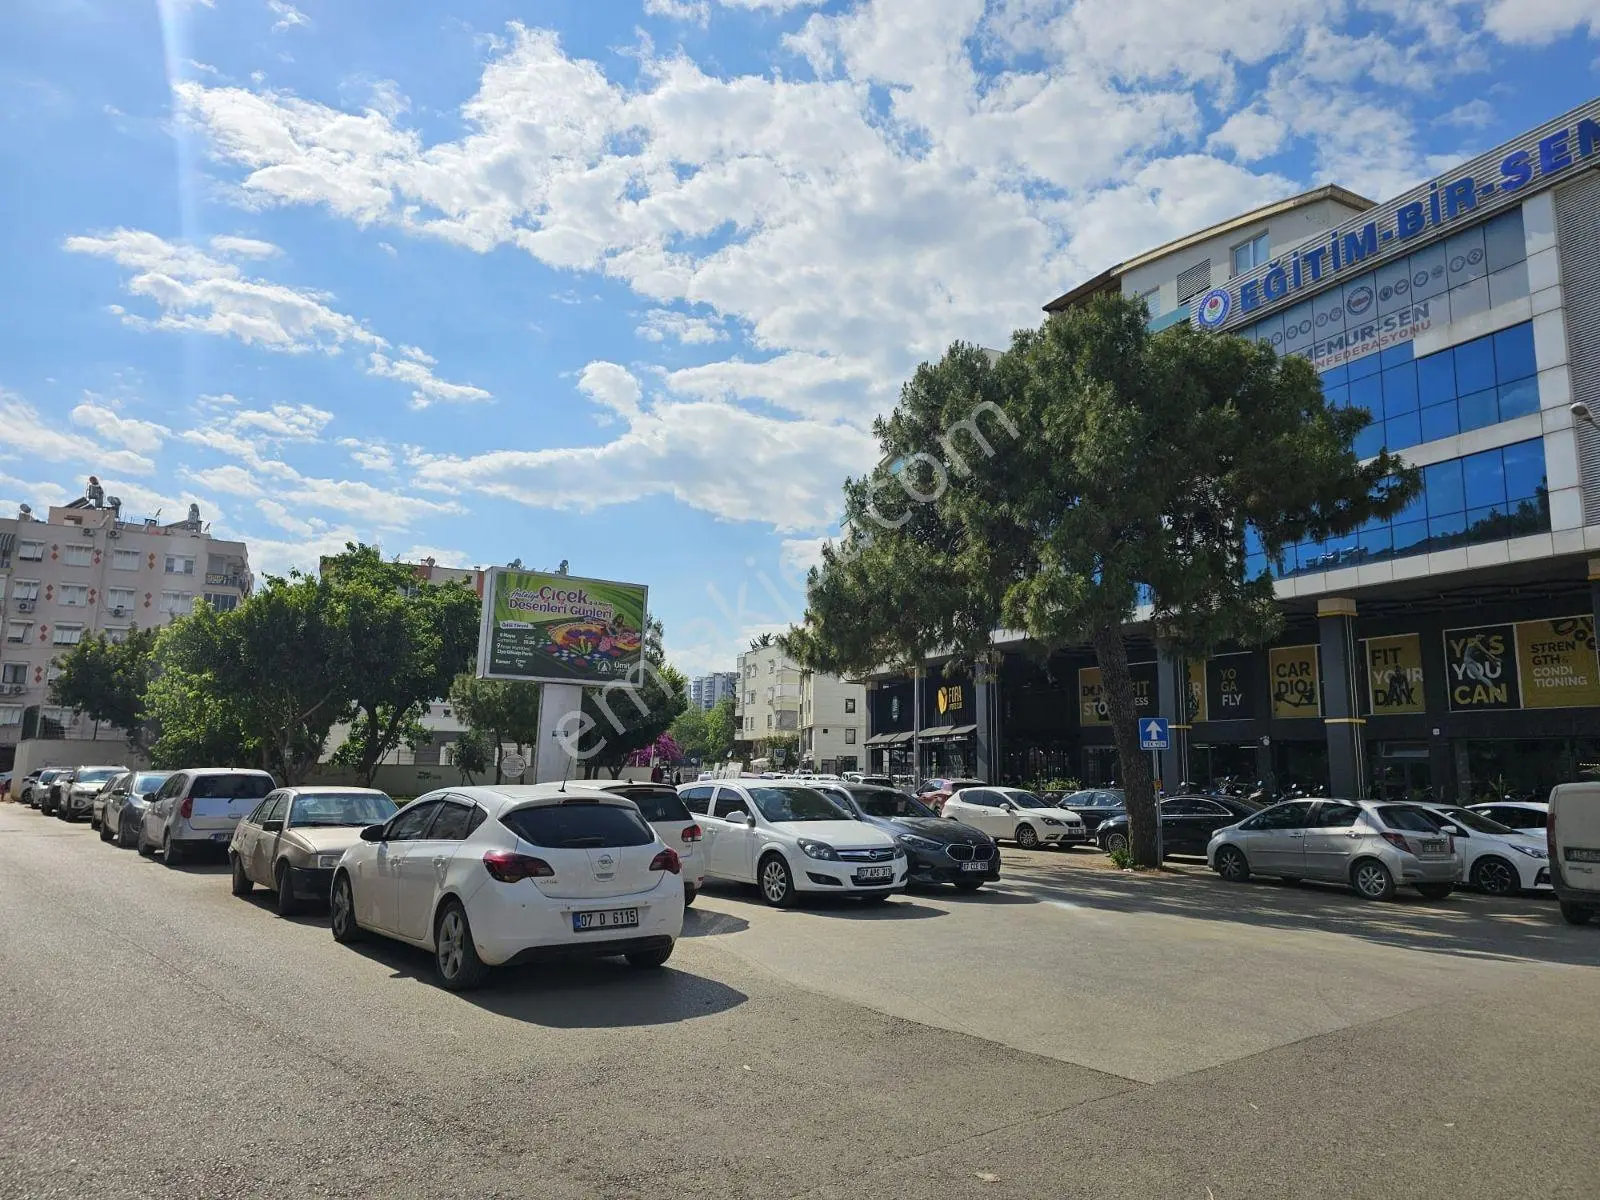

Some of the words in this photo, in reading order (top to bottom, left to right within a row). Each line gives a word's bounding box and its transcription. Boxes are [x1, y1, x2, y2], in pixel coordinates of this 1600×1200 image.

[509, 599, 567, 614] Desenleri
[1450, 635, 1505, 658] YS
[1531, 640, 1576, 653] STREN
[1371, 647, 1401, 666] FIT
[1532, 655, 1560, 665] GTH
[1220, 668, 1236, 680] YO
[1276, 661, 1311, 678] CAR
[1452, 661, 1502, 680] YOU
[1533, 665, 1573, 677] CONDI
[1132, 681, 1149, 696] IT
[1221, 681, 1237, 692] GA
[1534, 676, 1588, 687] TIONING
[1222, 693, 1242, 706] FLY
[1454, 683, 1508, 705] CAN
[581, 913, 592, 927] 07
[613, 910, 636, 923] 6115
